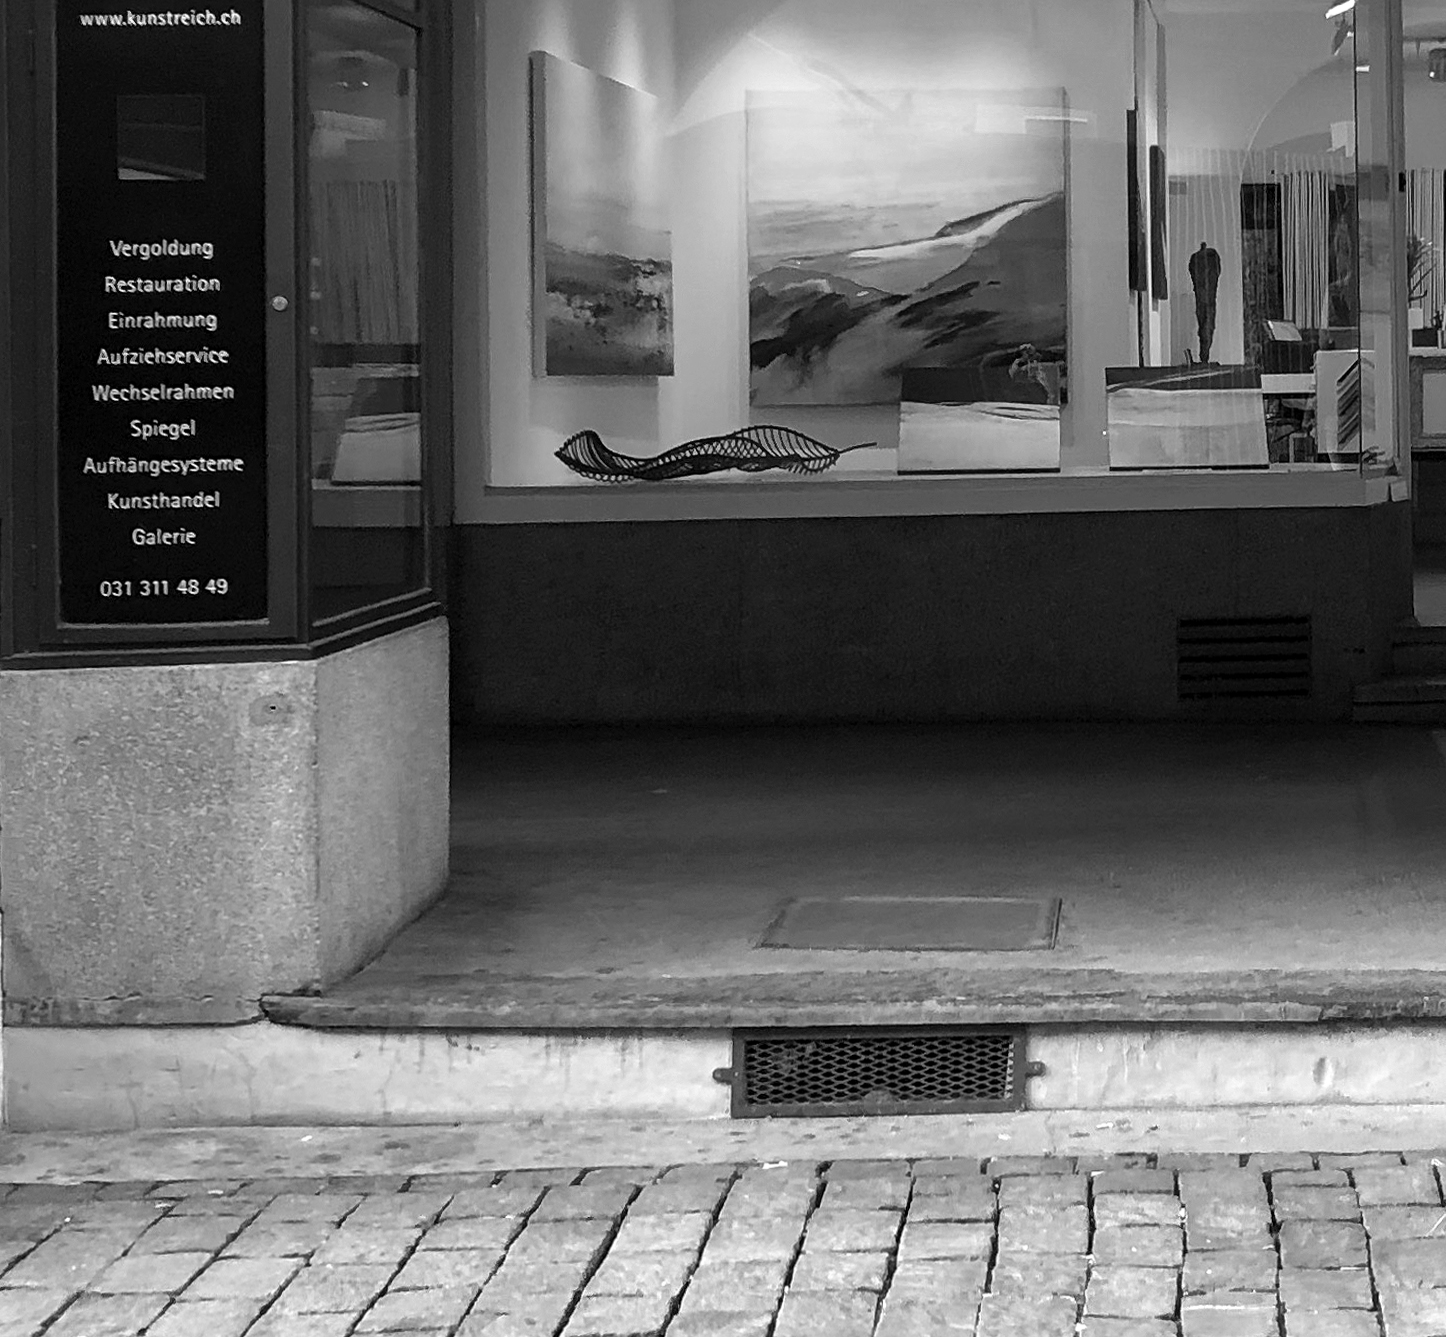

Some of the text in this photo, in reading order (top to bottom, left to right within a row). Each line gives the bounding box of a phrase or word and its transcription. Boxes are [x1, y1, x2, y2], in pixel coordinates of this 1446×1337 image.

[79, 8, 242, 27] www.kunstreich.ch
[109, 238, 215, 261] Vergoldung
[104, 274, 222, 294] Restauration
[107, 311, 218, 332] Einrahmung
[97, 346, 231, 366] Aufziehservice
[91, 383, 235, 403] Wechselrahmen
[129, 418, 196, 441] Spiegel
[82, 456, 245, 477] Aufhängesysteme
[107, 491, 221, 511] Kunsthandel
[131, 527, 197, 547] Galerie
[99, 578, 229, 598] 031 311 48 49
